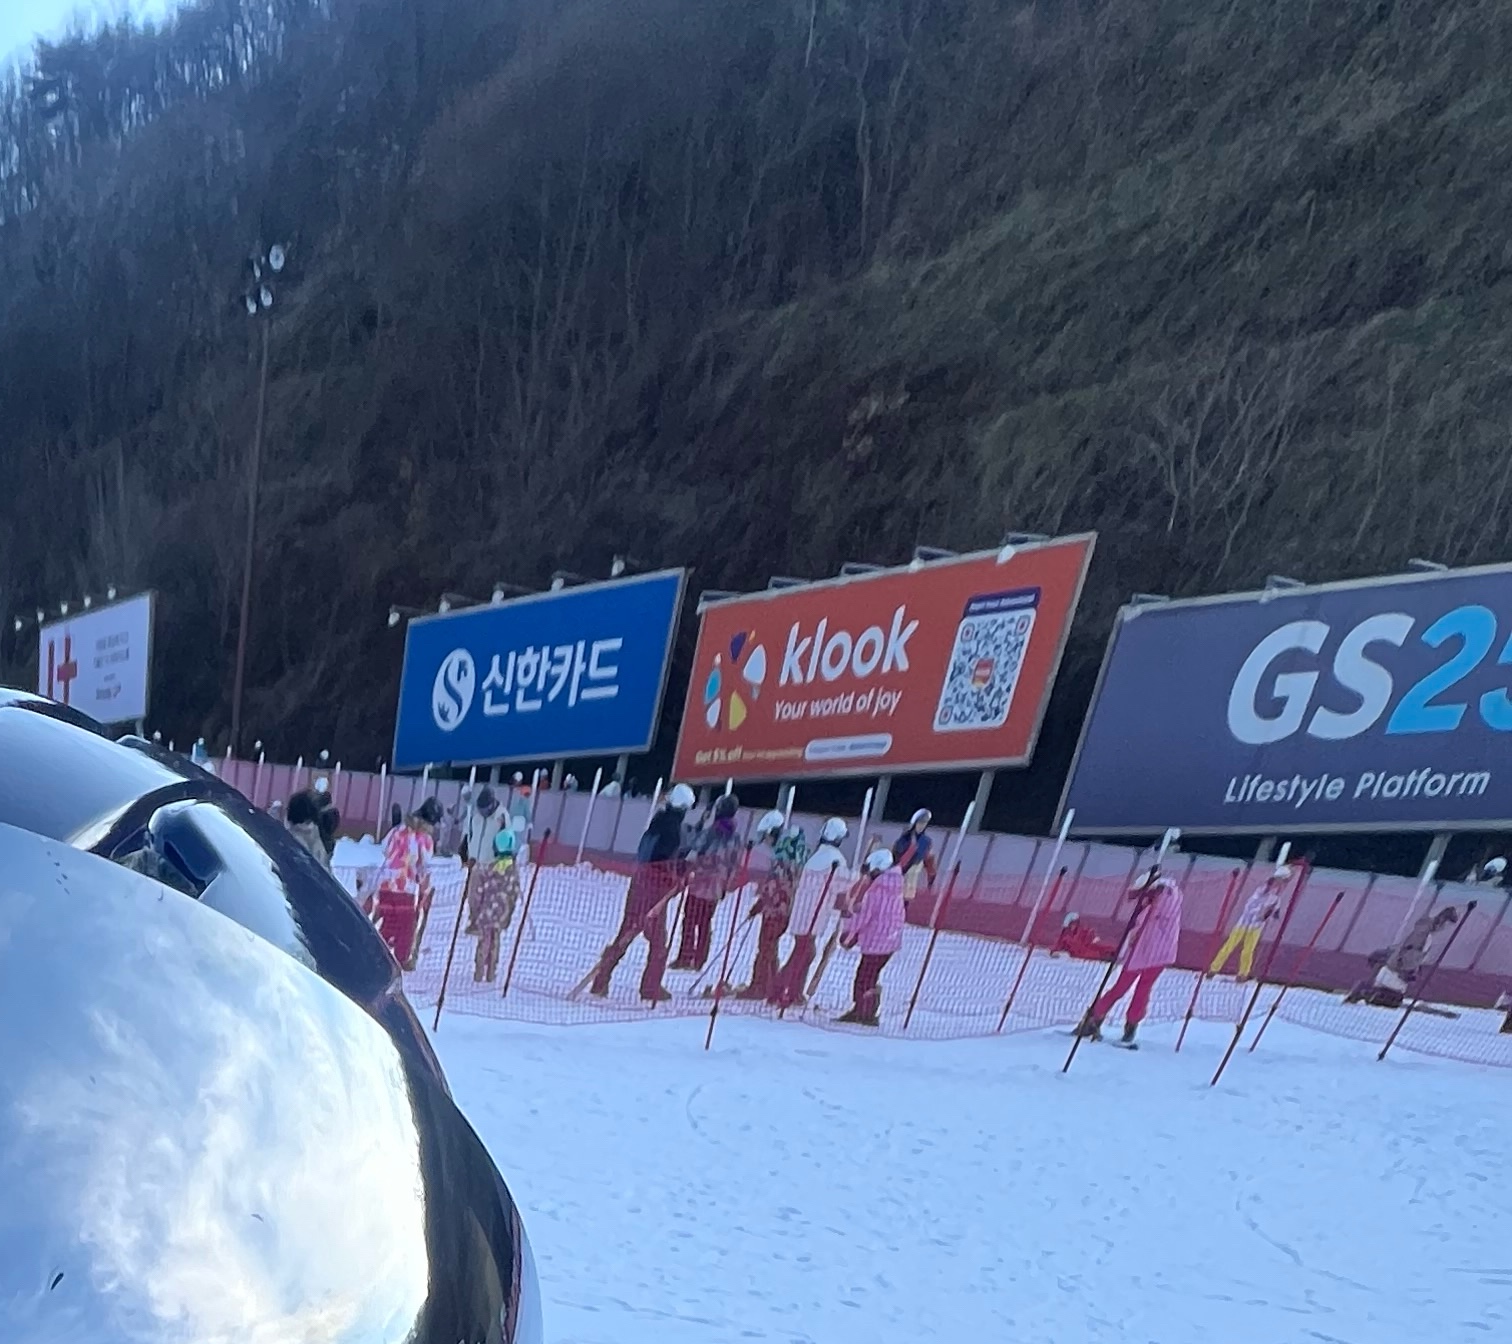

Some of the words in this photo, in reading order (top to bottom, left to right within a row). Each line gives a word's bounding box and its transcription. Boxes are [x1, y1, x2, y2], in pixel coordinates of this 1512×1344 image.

[779, 604, 919, 687] klook
[481, 637, 623, 716] 신한카드
[774, 700, 808, 722] Your
[810, 690, 855, 717] world
[855, 687, 875, 713] of
[871, 685, 903, 720] joy
[1224, 773, 1345, 809] Lifestyle
[1353, 767, 1491, 799] Platform
